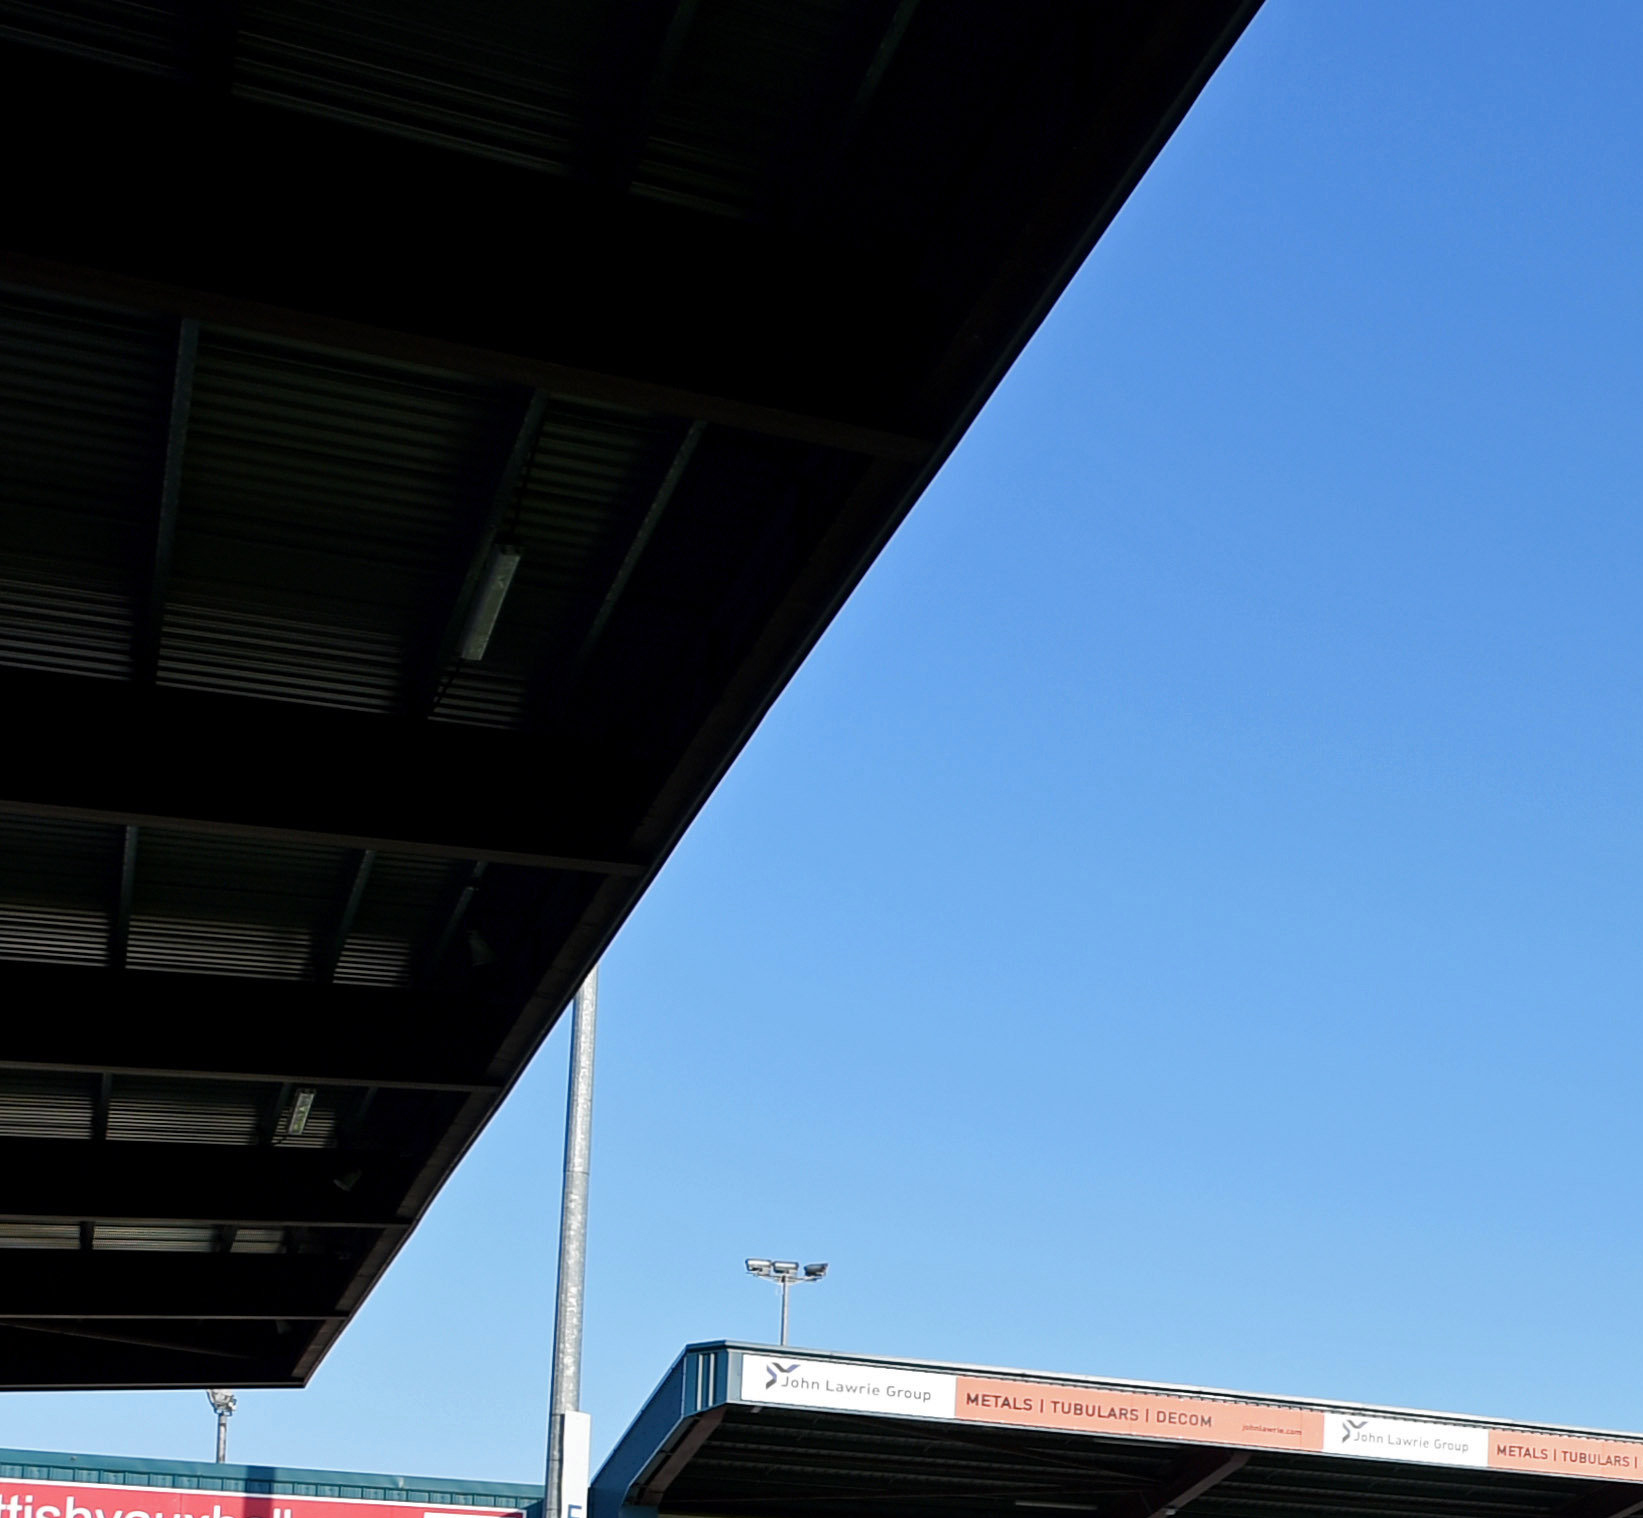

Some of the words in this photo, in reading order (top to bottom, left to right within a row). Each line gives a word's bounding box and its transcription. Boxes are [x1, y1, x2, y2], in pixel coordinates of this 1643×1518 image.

[781, 1376, 820, 1390] John
[826, 1380, 880, 1396] Lawrie
[886, 1386, 932, 1403] Group
[966, 1392, 1032, 1411] METALS
[1051, 1400, 1139, 1422] TUBULARS
[1157, 1410, 1212, 1428] DECOM
[1353, 1429, 1385, 1445] John
[1388, 1434, 1430, 1448] Lawrie
[1434, 1438, 1469, 1453] Group
[1497, 1444, 1549, 1460] METALS
[1562, 1451, 1630, 1468] TUBULARS
